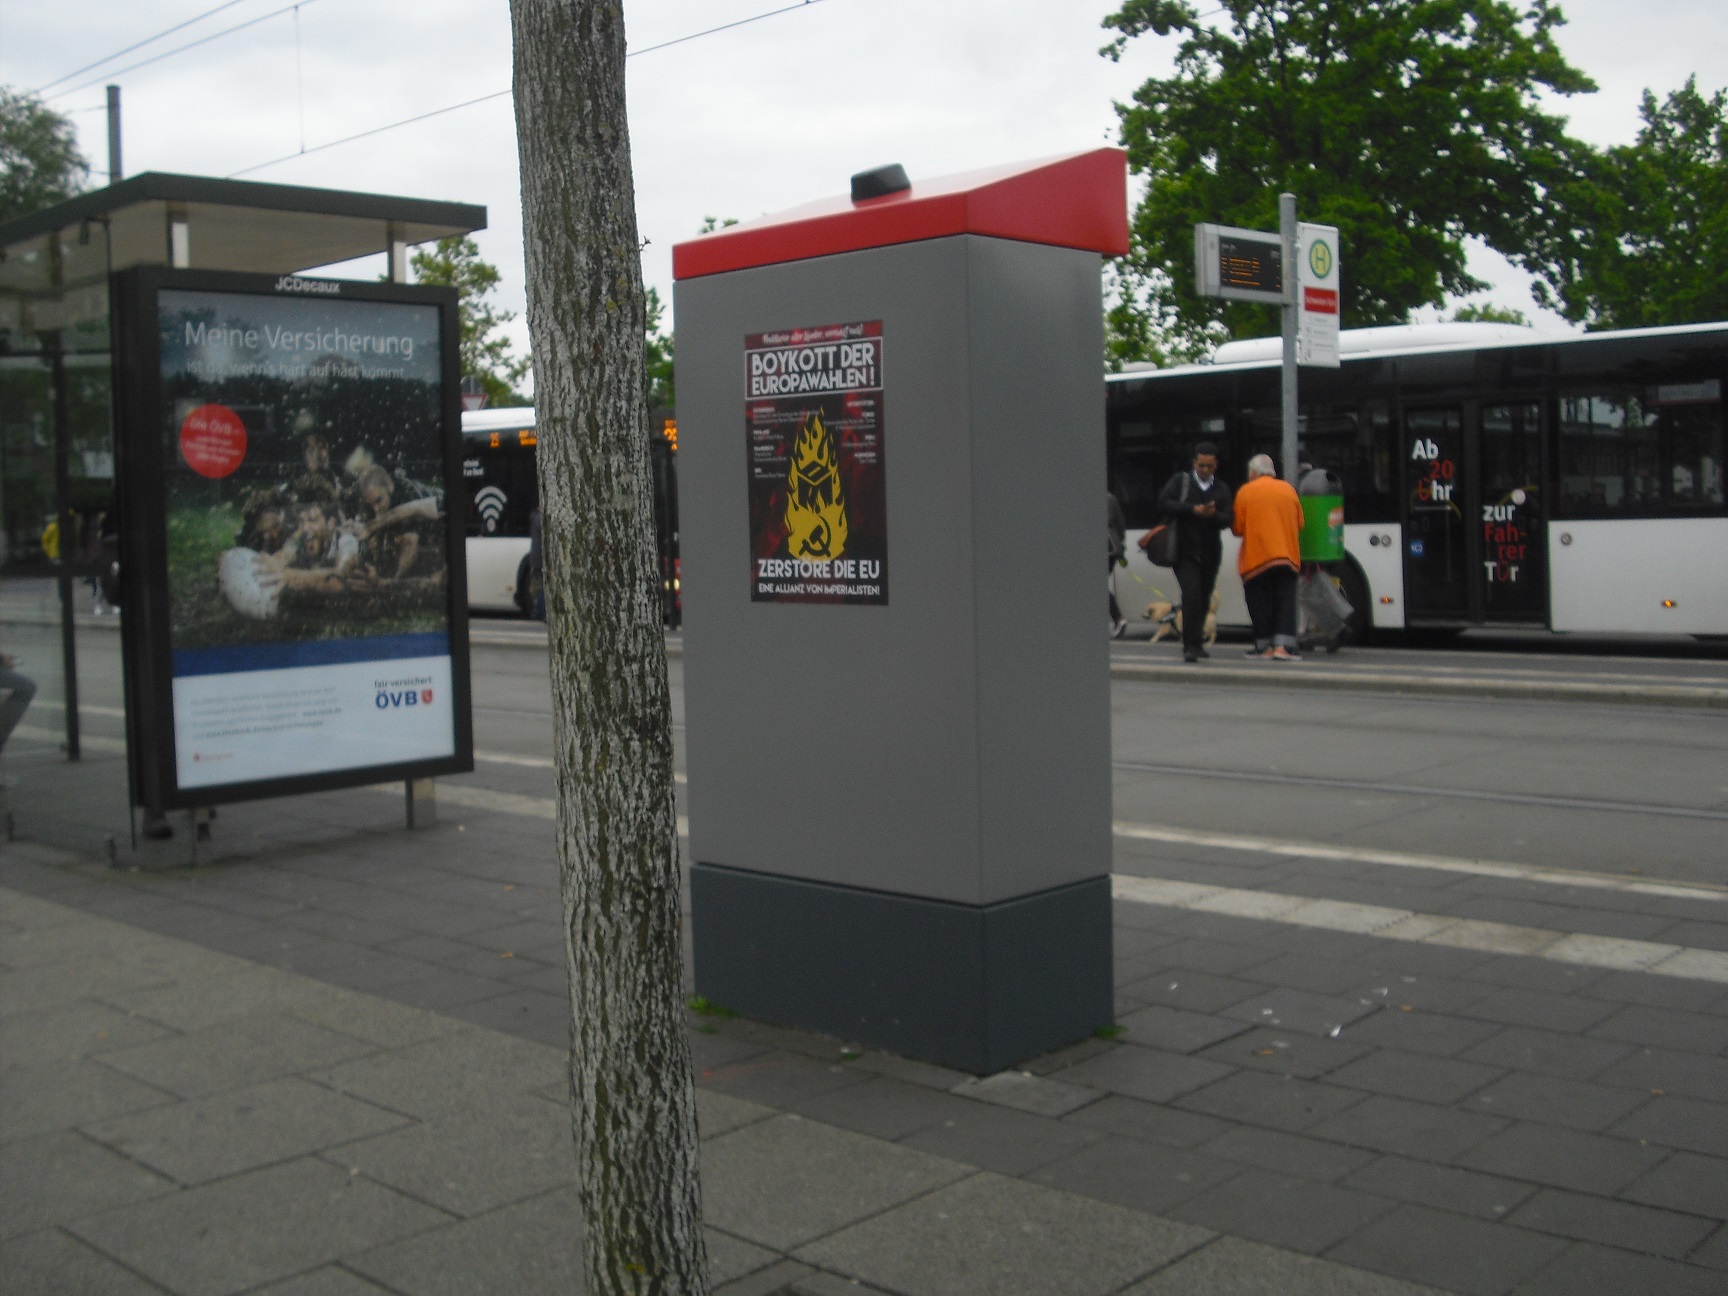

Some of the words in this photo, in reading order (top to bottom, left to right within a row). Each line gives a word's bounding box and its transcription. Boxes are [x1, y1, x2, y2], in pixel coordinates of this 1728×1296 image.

[275, 276, 341, 294] JCDecaux
[185, 321, 259, 349] Meine
[264, 325, 413, 361] Versicherung
[309, 360, 331, 377] auf
[751, 346, 837, 376] BOYKOTT
[840, 342, 875, 368] DER
[1411, 437, 1439, 460] Ab
[1429, 459, 1455, 480] 20
[1482, 504, 1516, 522] zur
[1484, 521, 1528, 542] Fah-
[1497, 543, 1528, 561] rer
[834, 559, 857, 579] DIE
[860, 560, 880, 579] EU
[758, 582, 774, 594] EINE
[775, 582, 805, 595] ALLIANZ
[807, 584, 823, 595] VON
[824, 584, 881, 596] IMPERIALISTEN!
[375, 689, 418, 710] ÖVB
